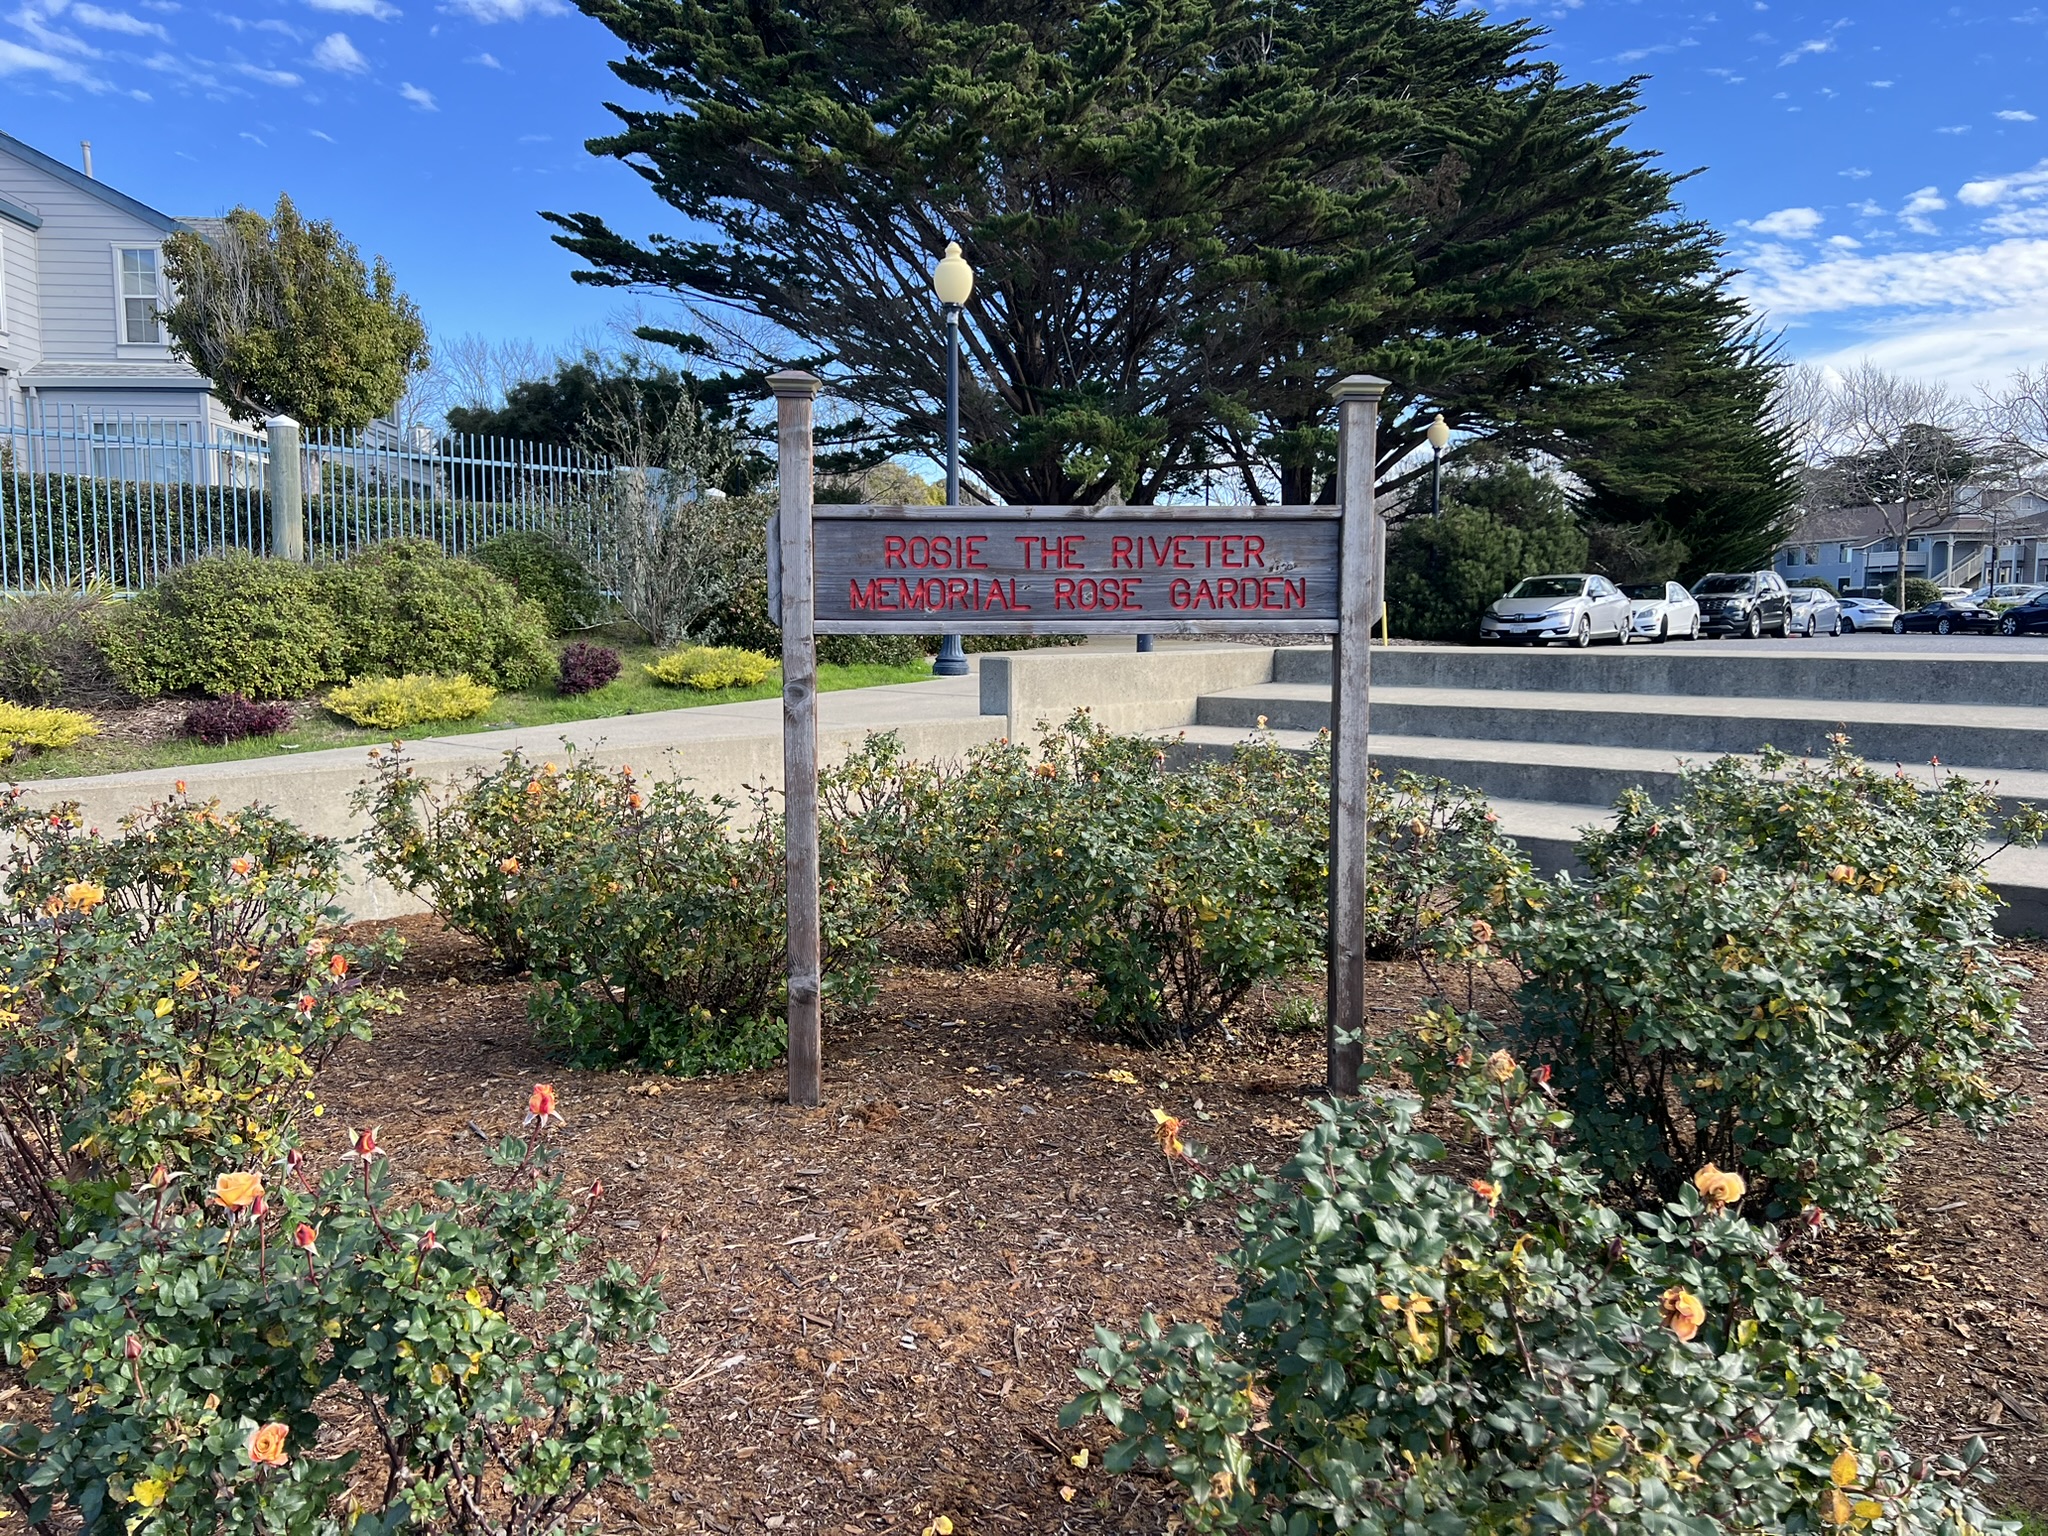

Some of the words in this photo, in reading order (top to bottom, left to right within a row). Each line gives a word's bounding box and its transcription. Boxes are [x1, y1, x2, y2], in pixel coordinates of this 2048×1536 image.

[885, 536, 987, 569] ROSIE
[1016, 536, 1086, 569] THE
[1112, 535, 1265, 568] RIVETER
[850, 578, 1030, 611] MEMORIAL
[1055, 578, 1142, 611] ROSE
[1170, 578, 1306, 610] GARDEN
